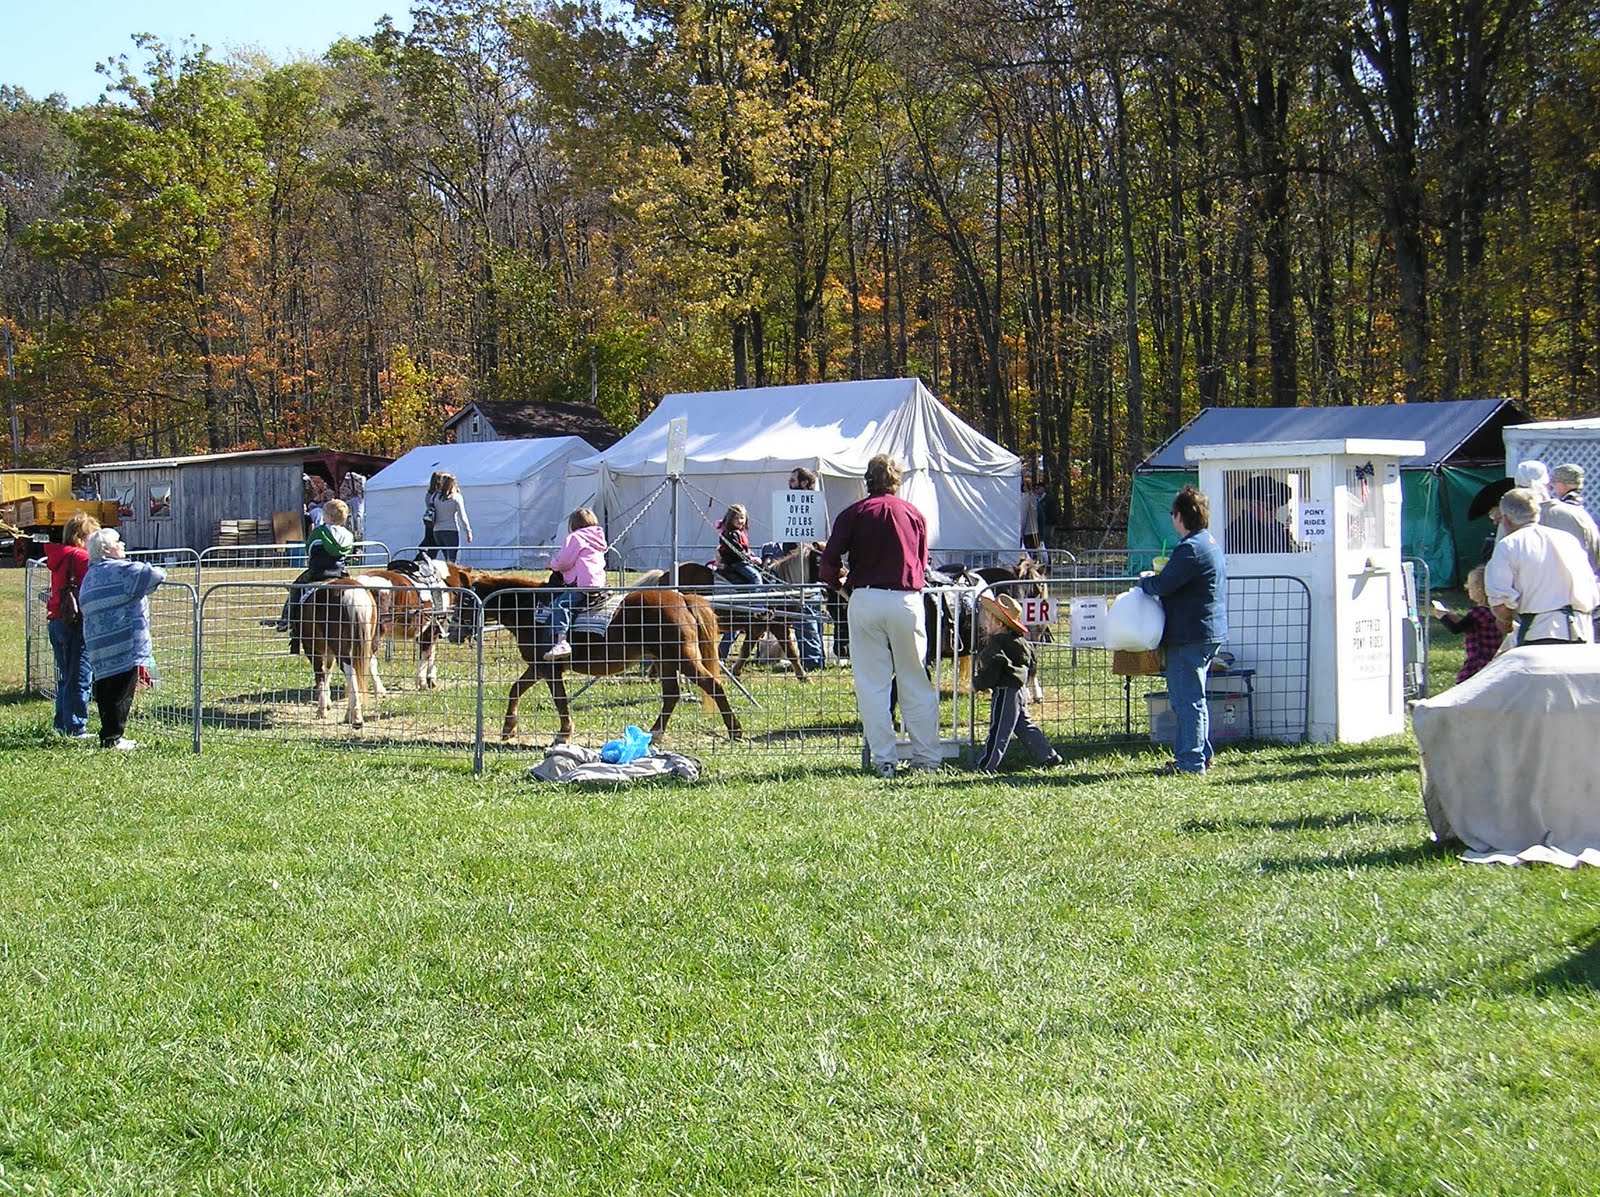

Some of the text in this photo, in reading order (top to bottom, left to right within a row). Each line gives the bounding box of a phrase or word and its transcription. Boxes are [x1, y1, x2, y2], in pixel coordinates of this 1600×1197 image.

[786, 494, 814, 504] NO ONE
[789, 505, 810, 514] OVER
[787, 516, 813, 526] 70 LBS
[785, 527, 815, 537] PLEASE
[1020, 601, 1050, 622] ER
